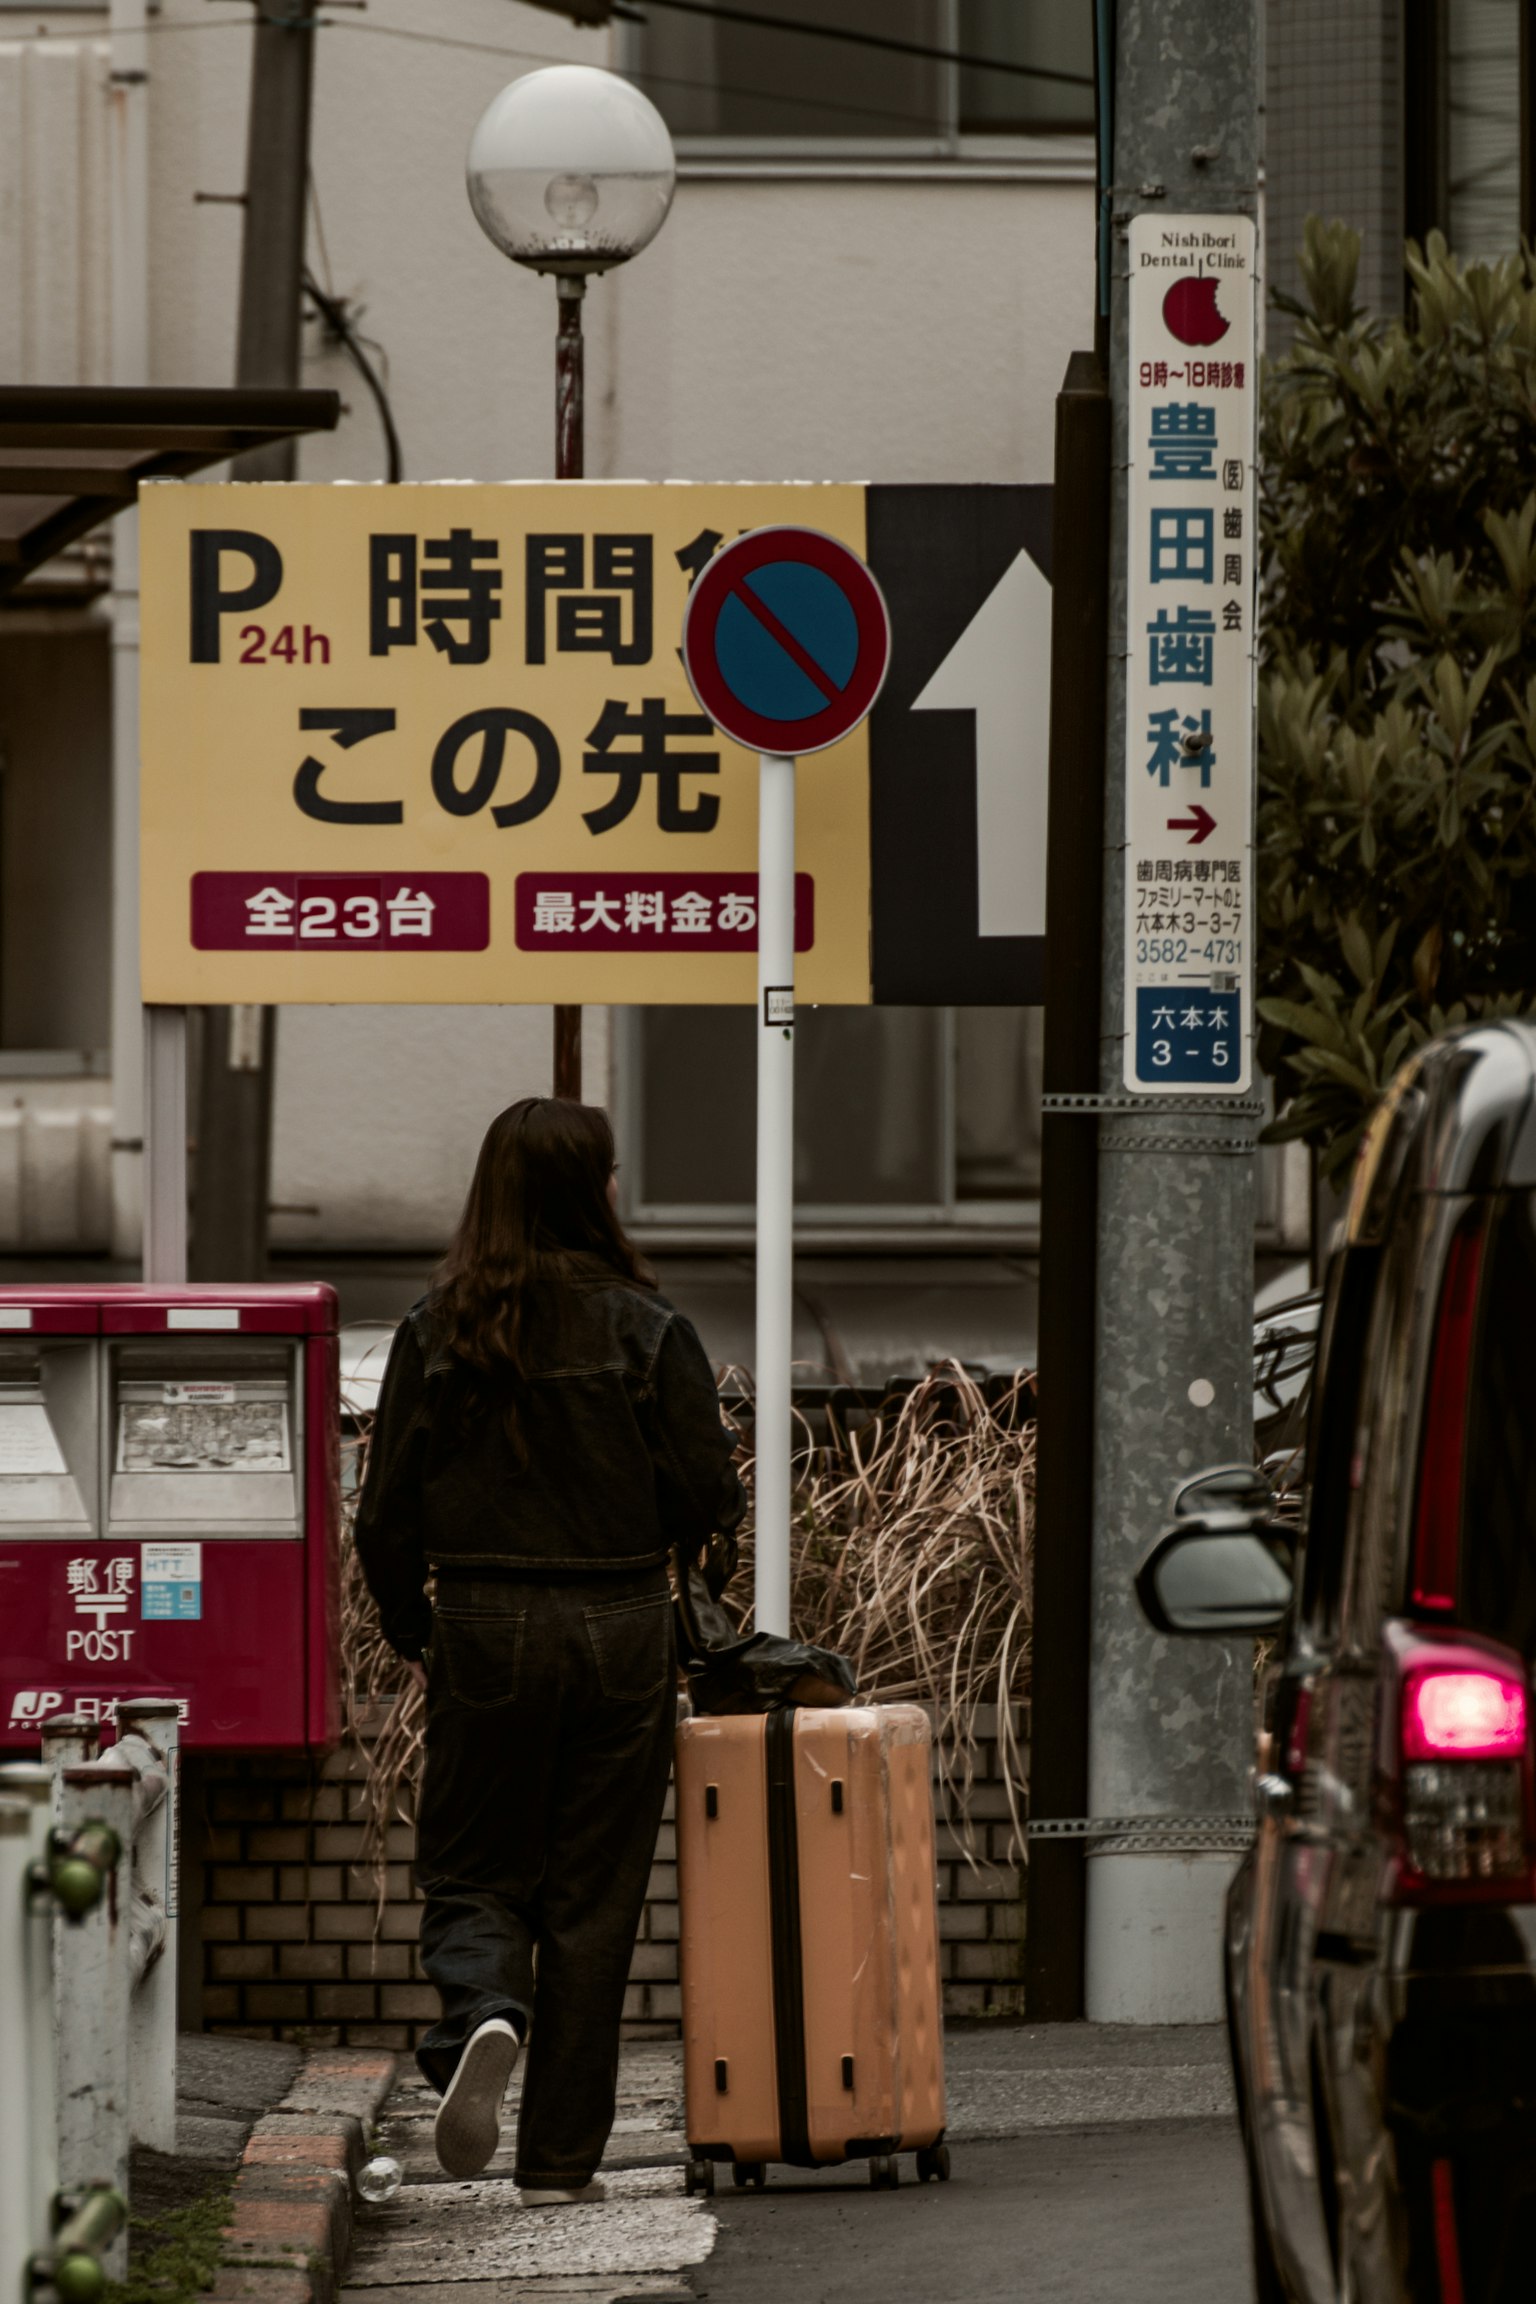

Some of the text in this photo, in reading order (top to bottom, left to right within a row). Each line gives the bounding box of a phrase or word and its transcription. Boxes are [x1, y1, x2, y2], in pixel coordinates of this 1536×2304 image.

[1162, 232, 1236, 249] Nishibori
[1140, 253, 1246, 269] Dental Clinic
[189, 529, 751, 666] P 時間
[1146, 402, 1218, 788] 豊田歯科
[239, 624, 331, 664] 24h
[293, 698, 722, 836] この先
[1136, 859, 1241, 882] 歯周病専門医
[533, 891, 757, 933] 最大料金あ
[1136, 886, 1241, 909] ファミリーマートの上
[244, 887, 436, 940] 全23台
[1136, 911, 1241, 934] 六本木3-3-7
[1136, 938, 1242, 964] 3582-4731
[1152, 1006, 1229, 1031] 六本木
[67, 1557, 135, 1595] 郵便
[67, 1630, 135, 1661] POST
